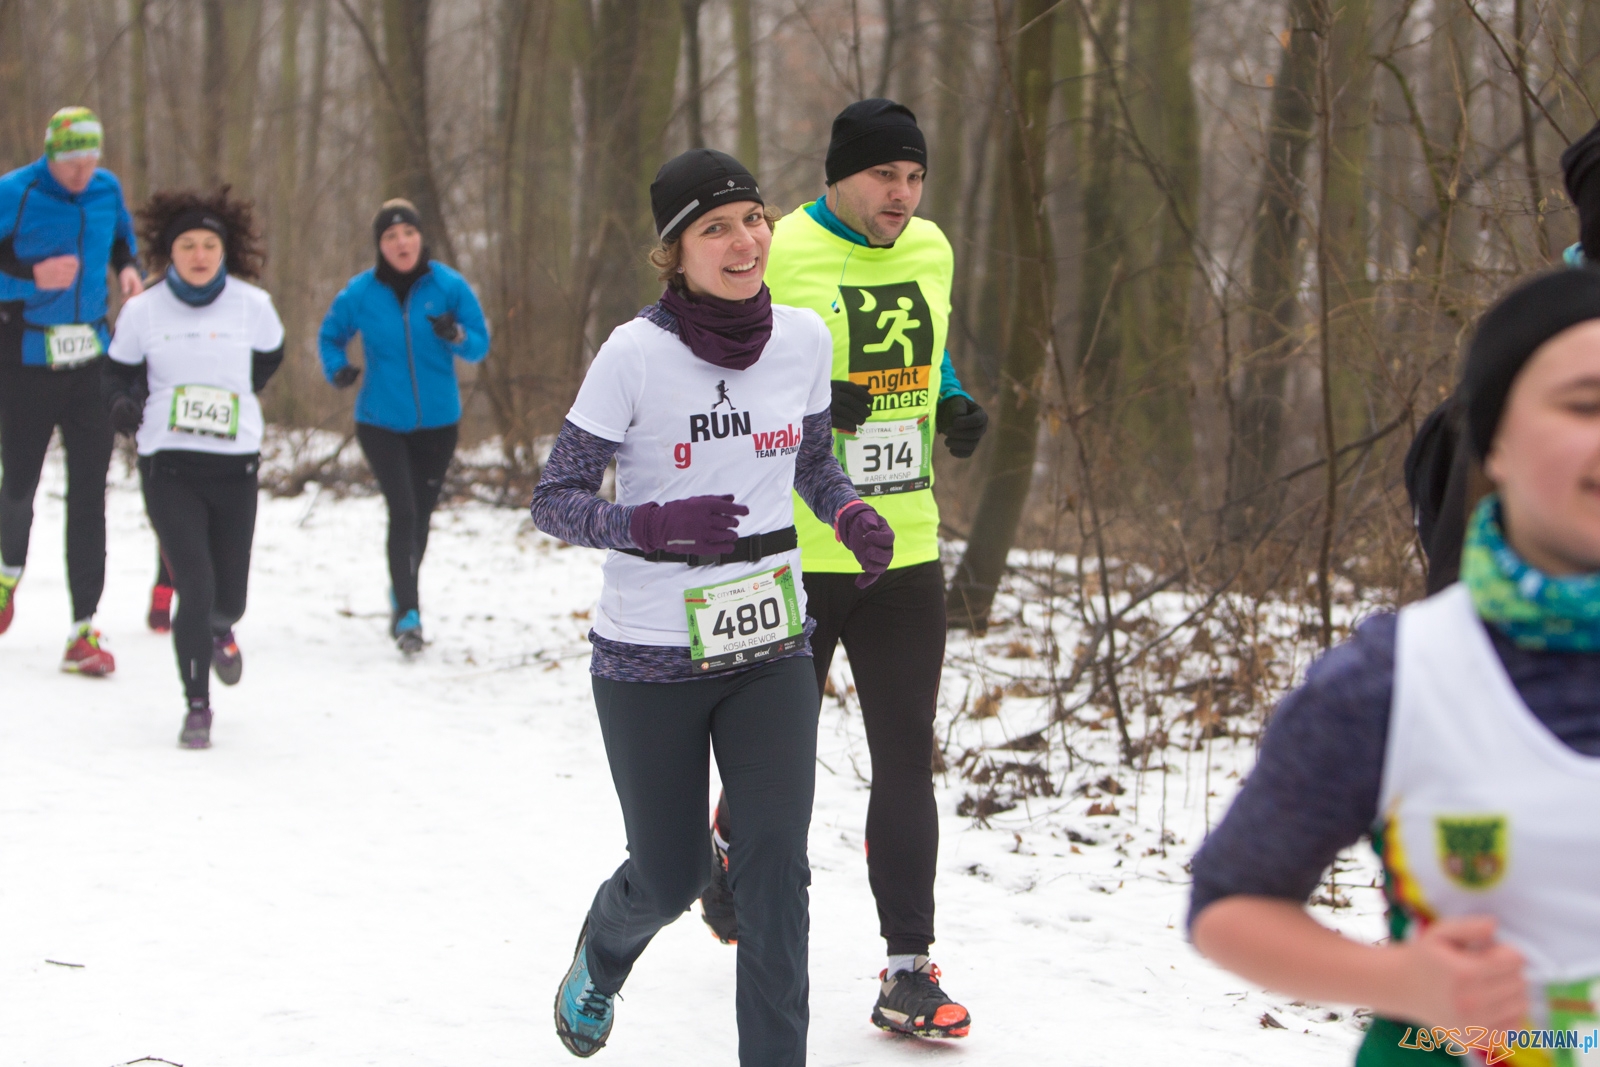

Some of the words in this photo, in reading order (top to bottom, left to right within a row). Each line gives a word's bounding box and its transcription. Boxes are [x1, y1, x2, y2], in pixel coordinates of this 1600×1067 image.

[867, 368, 918, 392] night
[182, 399, 230, 424] 1543
[871, 390, 928, 411] nners
[674, 442, 691, 469] g
[690, 411, 752, 443] RUN
[755, 448, 777, 459] TEAM
[863, 441, 913, 472] 314
[712, 597, 780, 639] 480
[723, 640, 747, 652] KOSIA
[748, 632, 777, 647] REWOR
